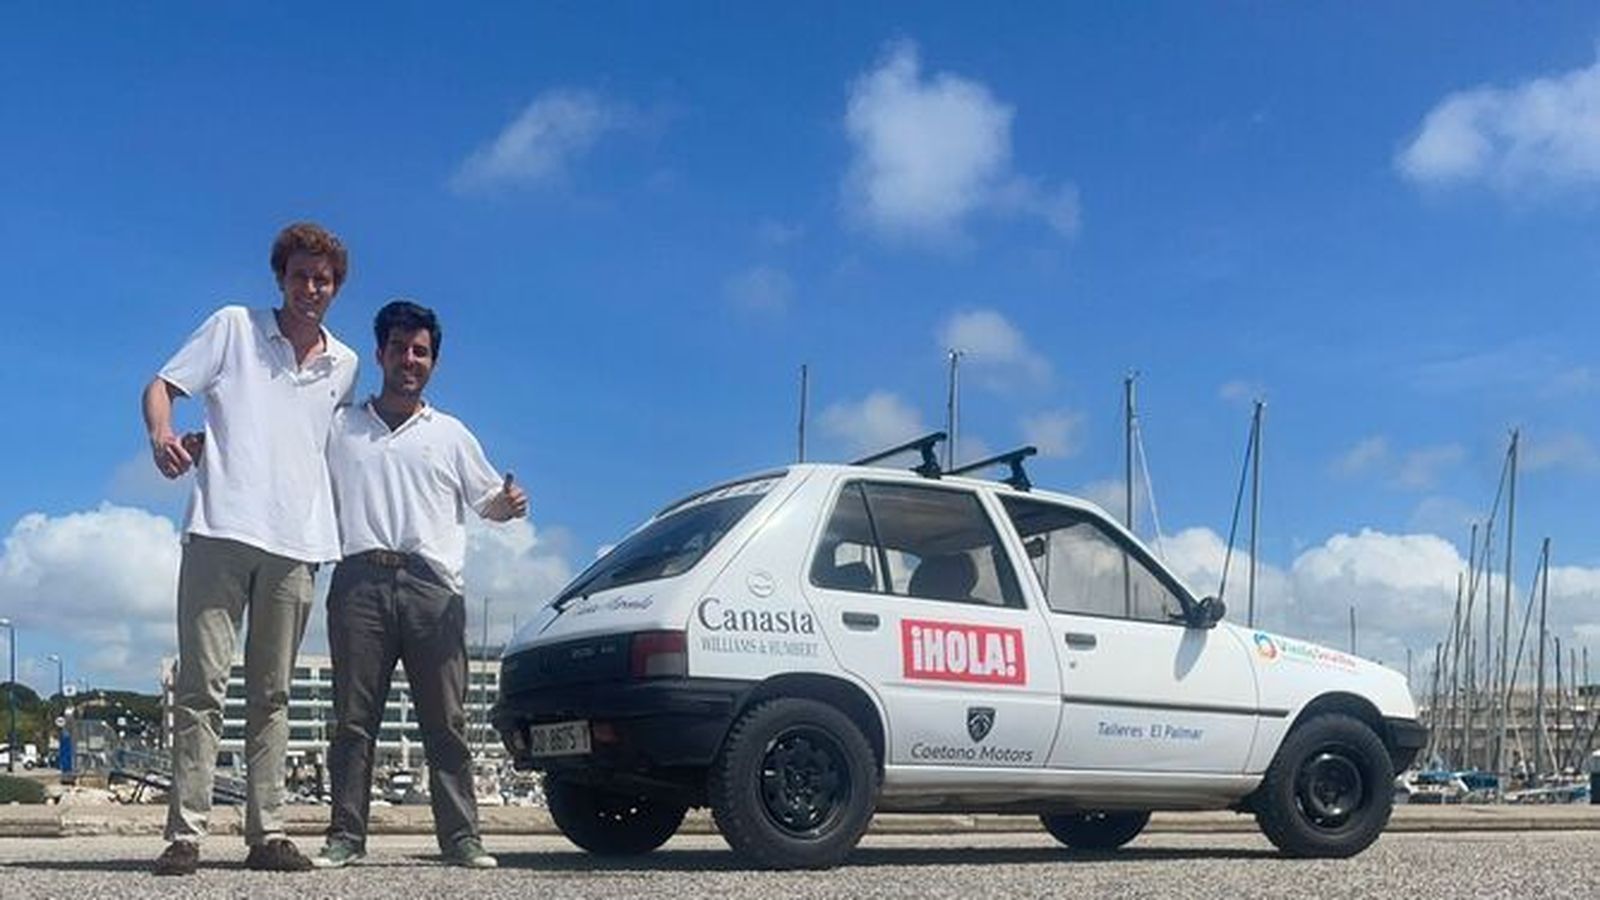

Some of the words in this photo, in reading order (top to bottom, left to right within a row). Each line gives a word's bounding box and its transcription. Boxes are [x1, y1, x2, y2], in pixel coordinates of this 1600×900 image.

[698, 597, 816, 634] Canasta
[701, 637, 757, 654] WILLIAMS
[759, 640, 768, 654] &
[911, 625, 1016, 678] ¡HOLA!
[1098, 721, 1143, 737] Talleres
[1150, 724, 1162, 738] El
[980, 745, 1033, 762] Motors
